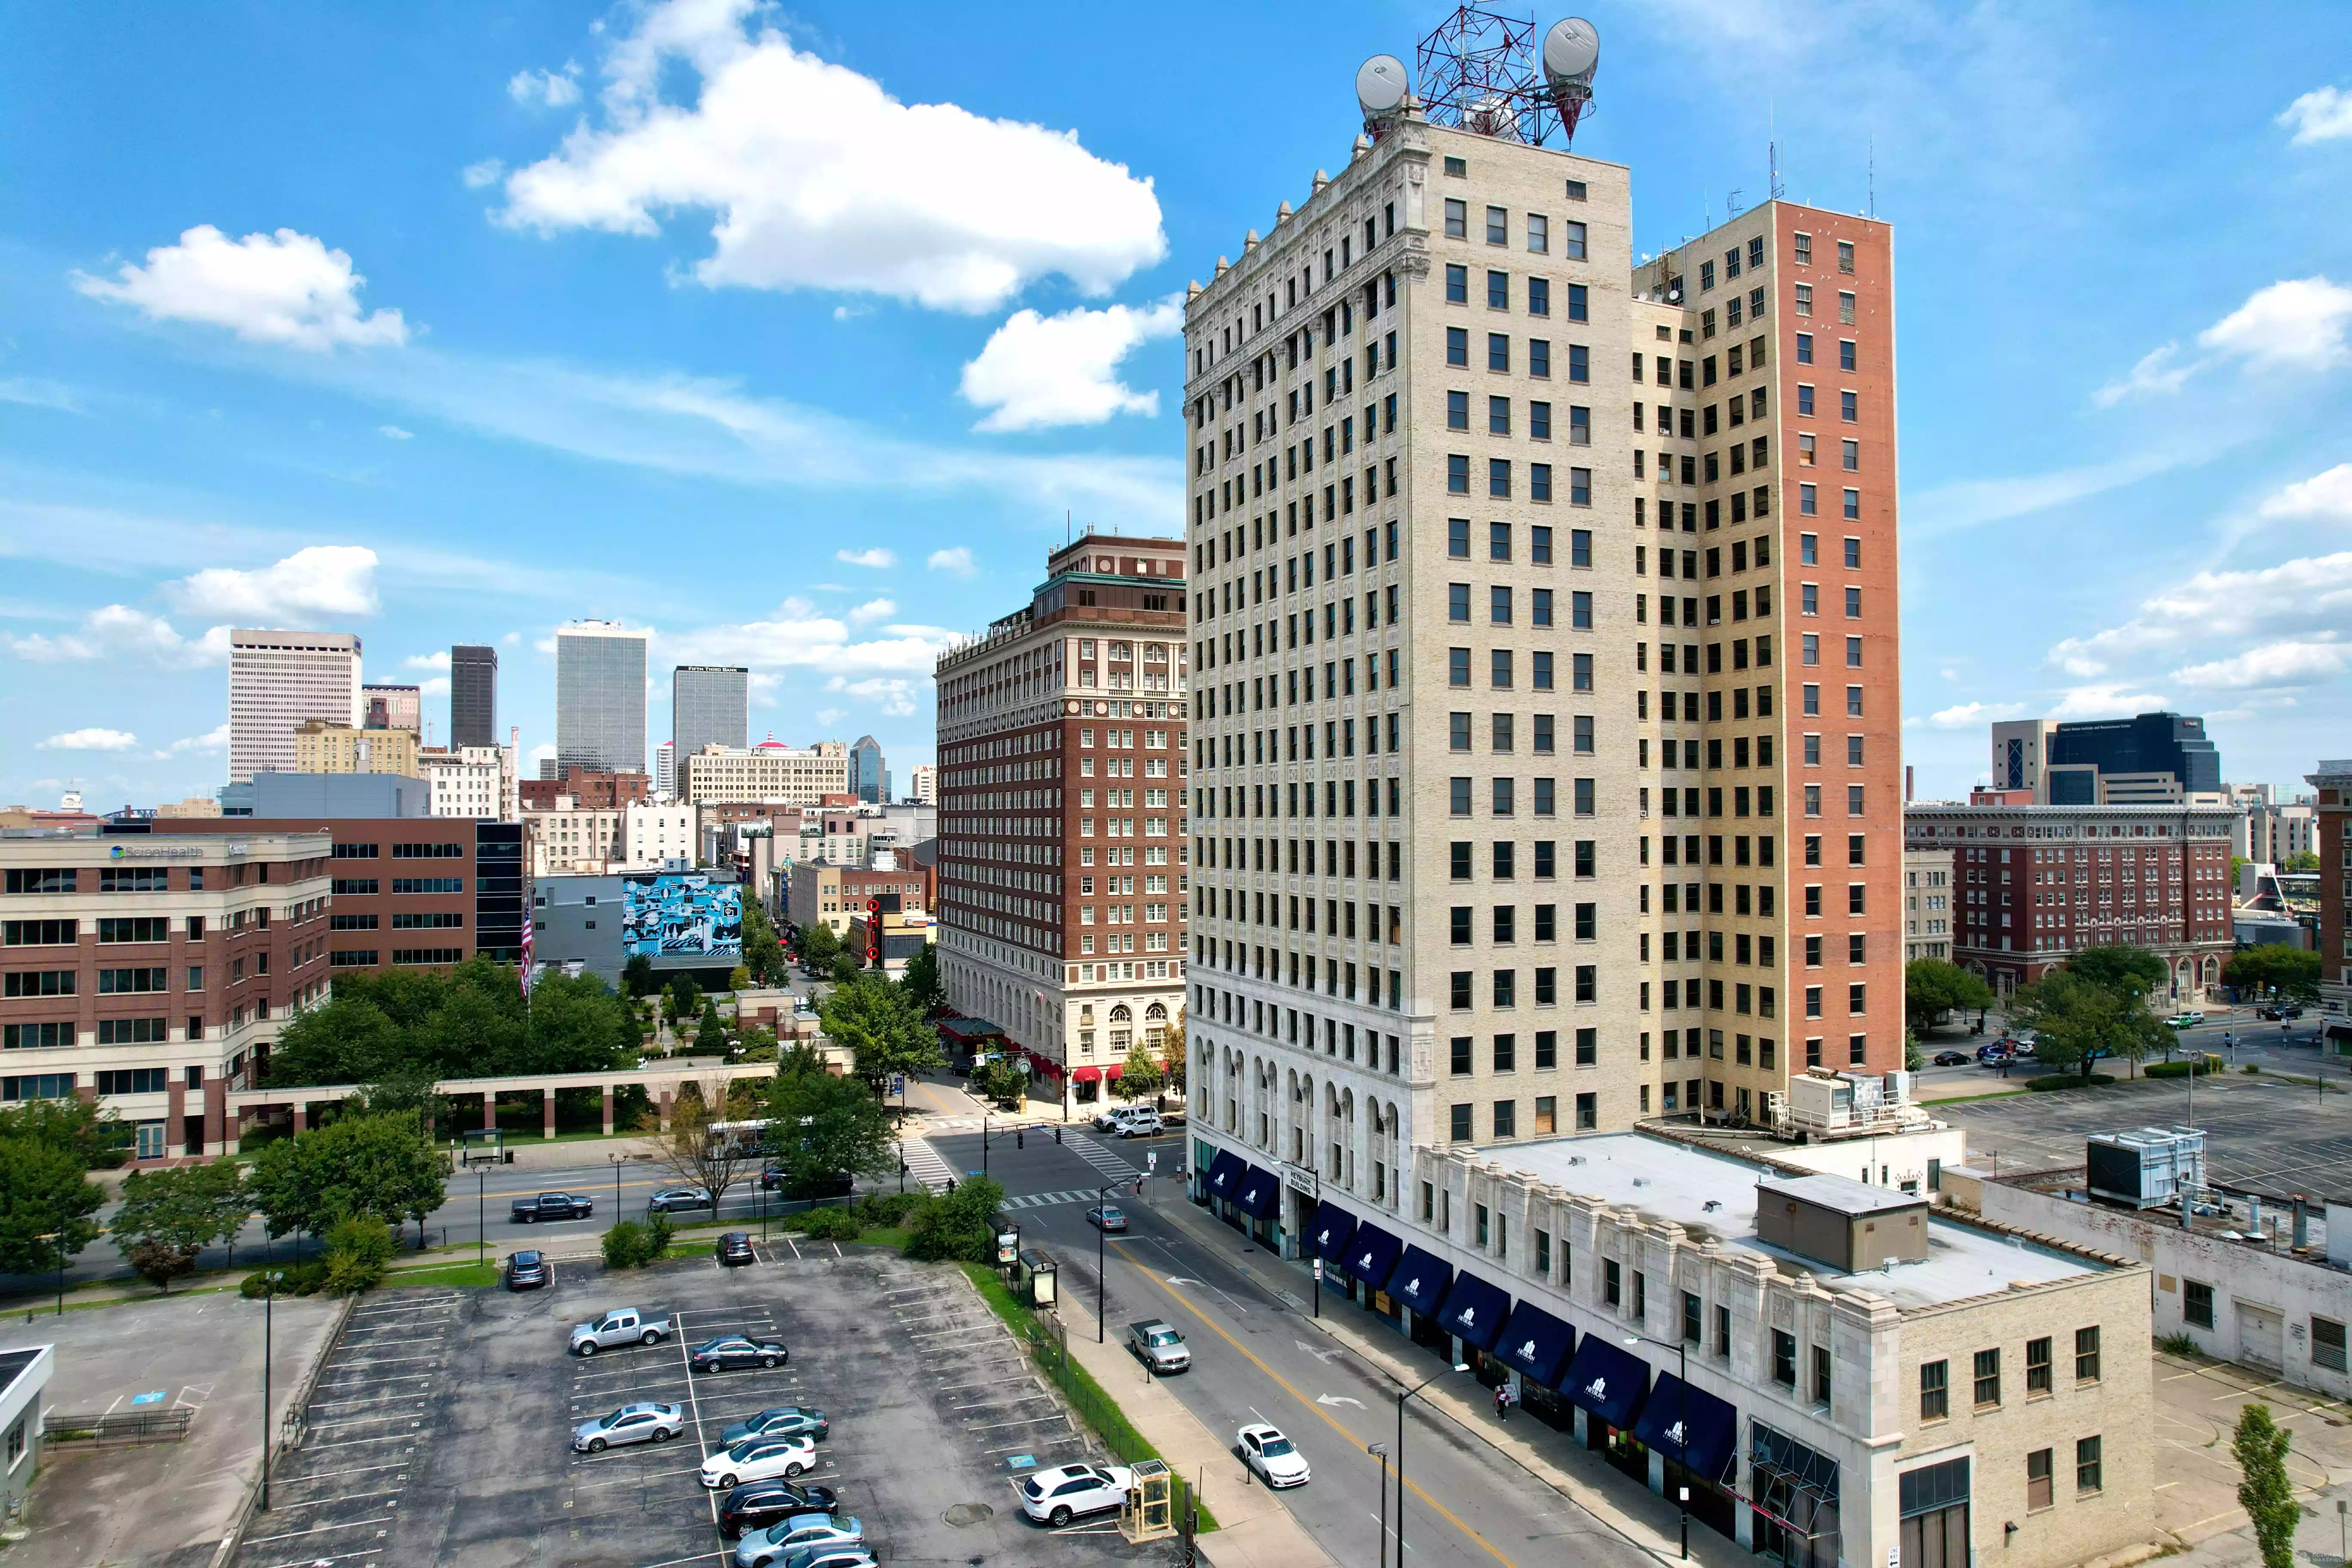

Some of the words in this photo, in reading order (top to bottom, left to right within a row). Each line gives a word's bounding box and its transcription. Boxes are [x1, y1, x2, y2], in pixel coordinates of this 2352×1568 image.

[126, 846, 203, 857] ScionHealth
[867, 899, 880, 960] OHIO
[1291, 1170, 1311, 1184] HEYBURN
[1291, 1179, 1311, 1194] BUILDING
[1458, 1314, 1474, 1327] HEYBURN
[1517, 1348, 1535, 1361] HEYBURN
[1585, 1385, 1606, 1400] HEYBURN
